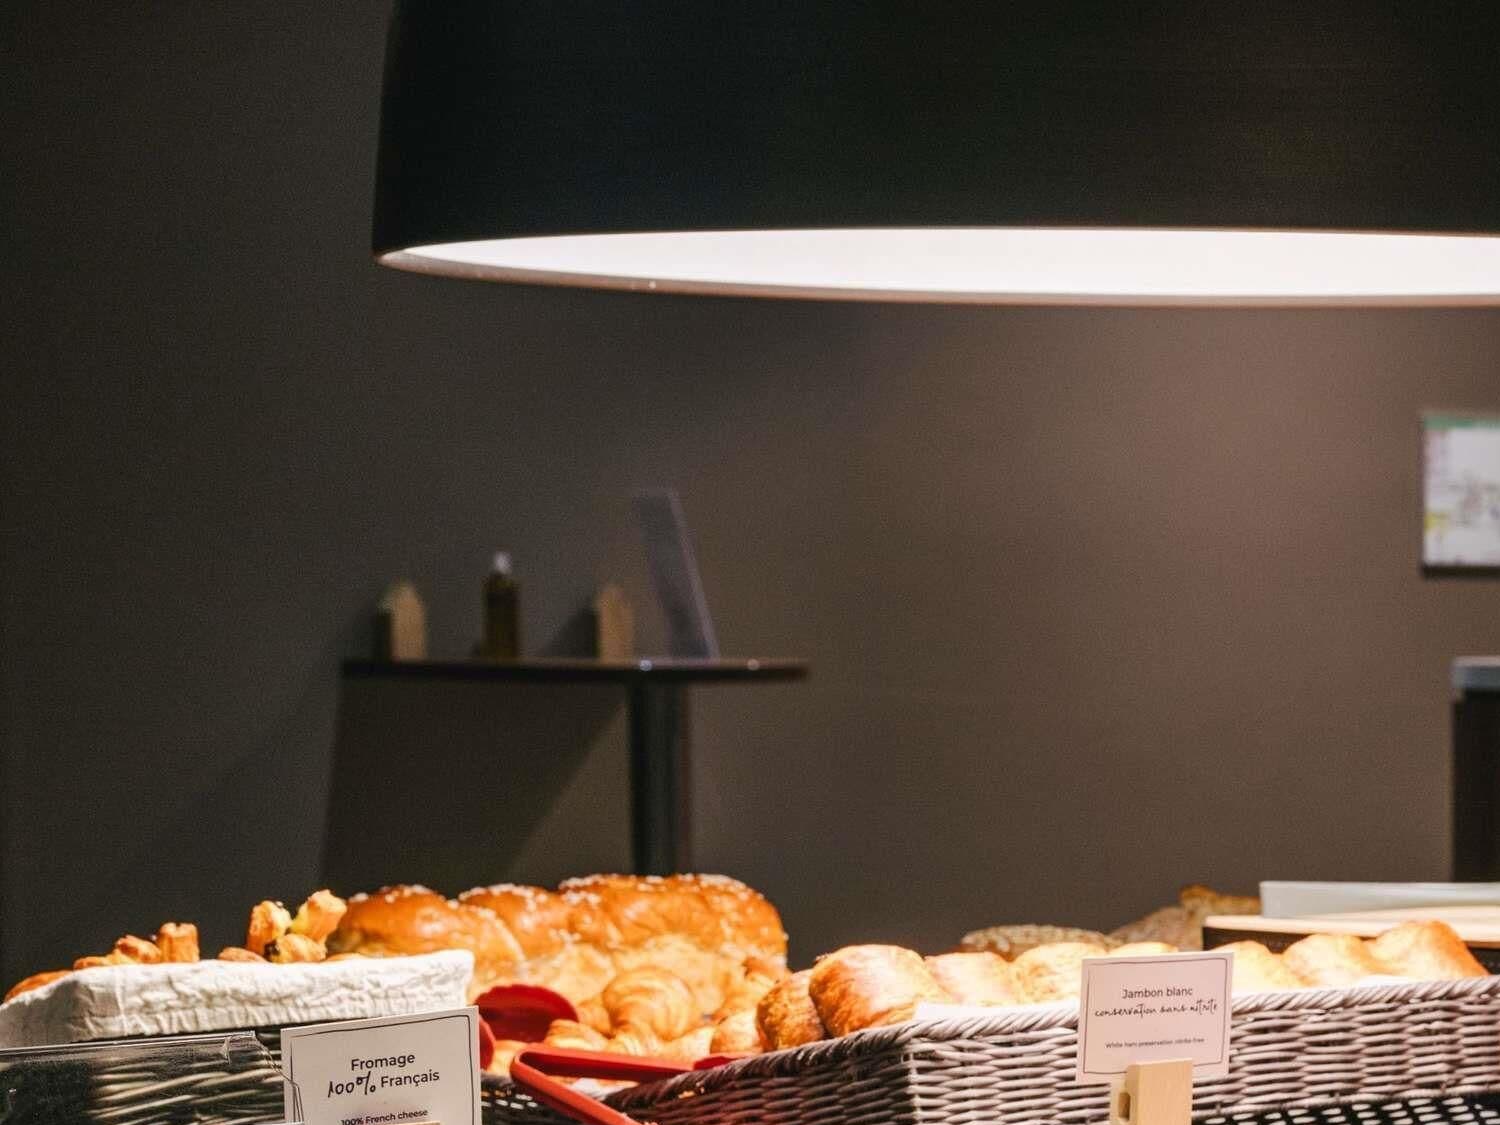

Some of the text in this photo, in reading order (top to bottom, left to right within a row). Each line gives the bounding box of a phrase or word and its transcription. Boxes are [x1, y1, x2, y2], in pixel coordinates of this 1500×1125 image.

[1121, 986, 1193, 1000] Jambon blanc
[1094, 1003, 1158, 1018] conservation
[351, 1054, 415, 1070] Fromage
[328, 1069, 440, 1098] 100% Français
[365, 1113, 396, 1124] French
[398, 1109, 428, 1119] cheese
